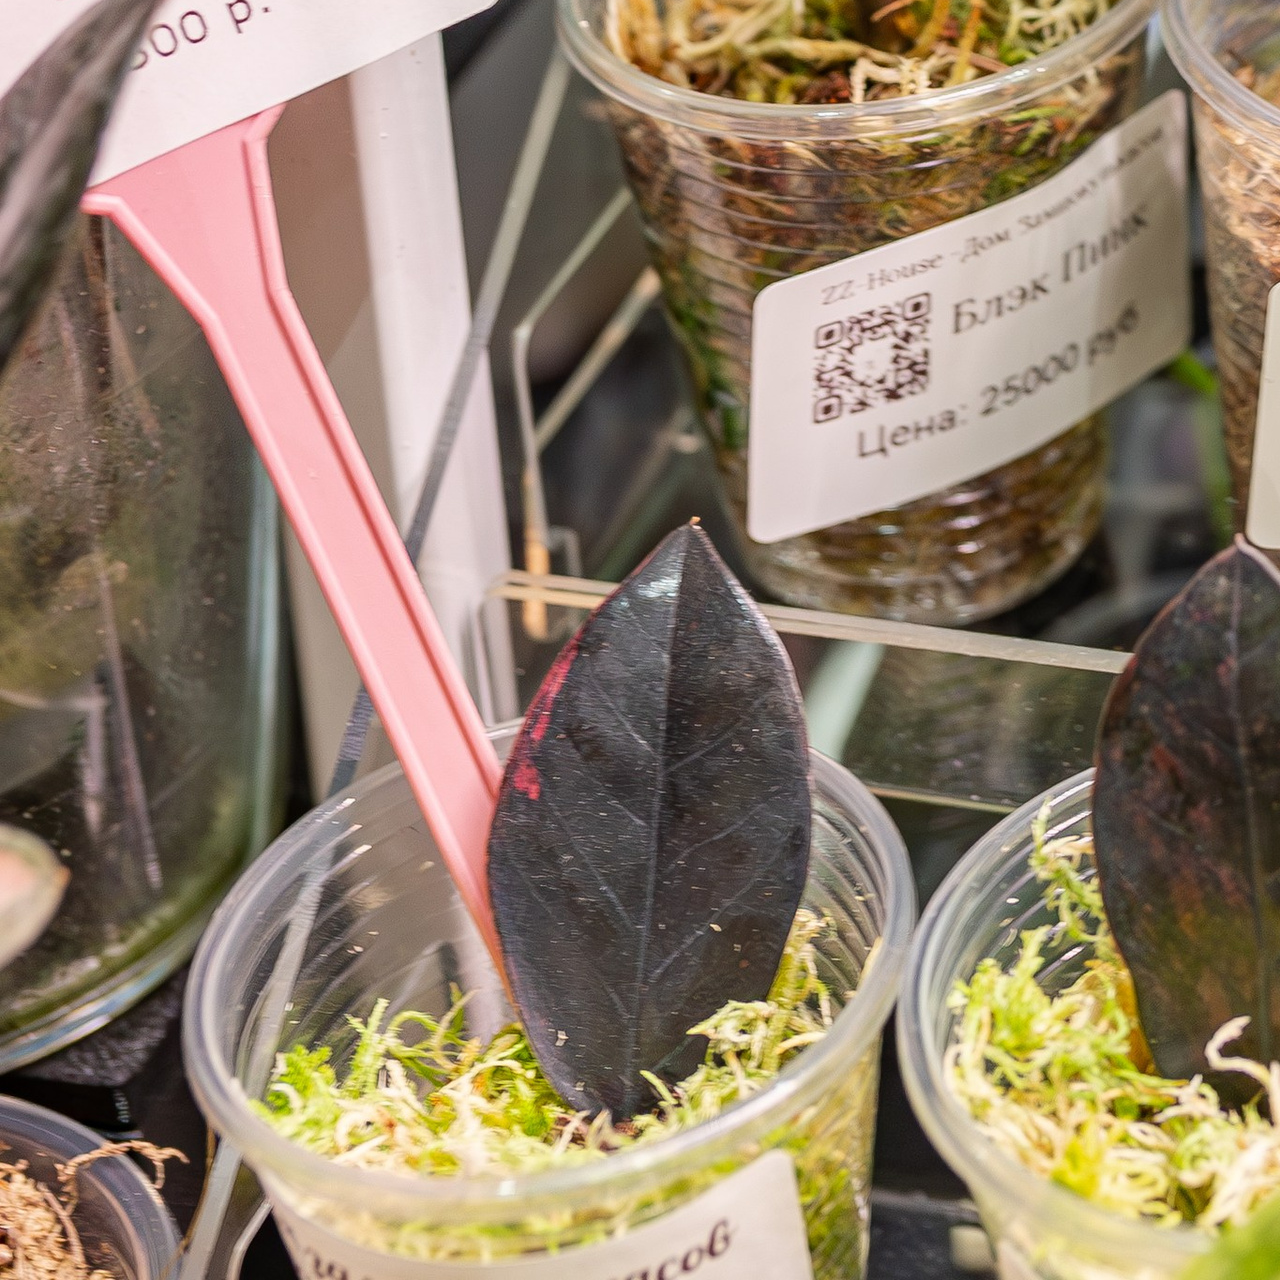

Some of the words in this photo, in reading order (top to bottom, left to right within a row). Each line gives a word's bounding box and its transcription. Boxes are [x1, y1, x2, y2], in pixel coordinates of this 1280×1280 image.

[820, 252, 943, 307] ZZ-House
[951, 270, 1052, 334] Блэк
[1061, 201, 1150, 285] Пинк
[856, 405, 968, 460] Цена:
[979, 342, 1080, 418] 25000
[1086, 298, 1141, 369] руб
